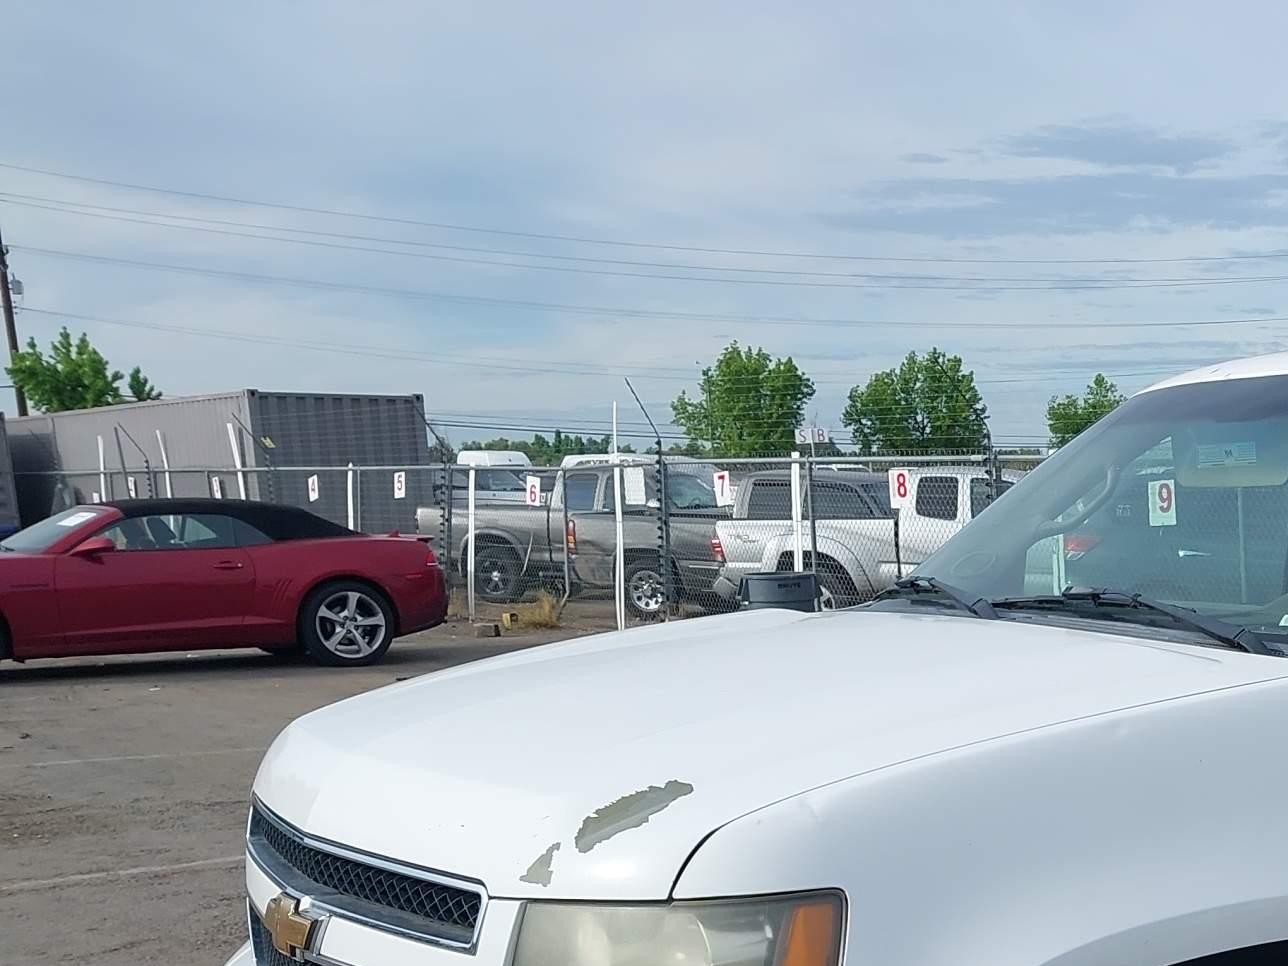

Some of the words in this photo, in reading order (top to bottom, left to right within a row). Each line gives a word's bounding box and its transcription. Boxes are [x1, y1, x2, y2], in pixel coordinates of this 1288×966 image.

[799, 429, 807, 444] S
[817, 428, 826, 443] B
[396, 473, 404, 492] 5
[717, 473, 726, 497] 7
[896, 472, 908, 499] 8
[529, 484, 538, 503] 6
[1157, 482, 1173, 514] 9
